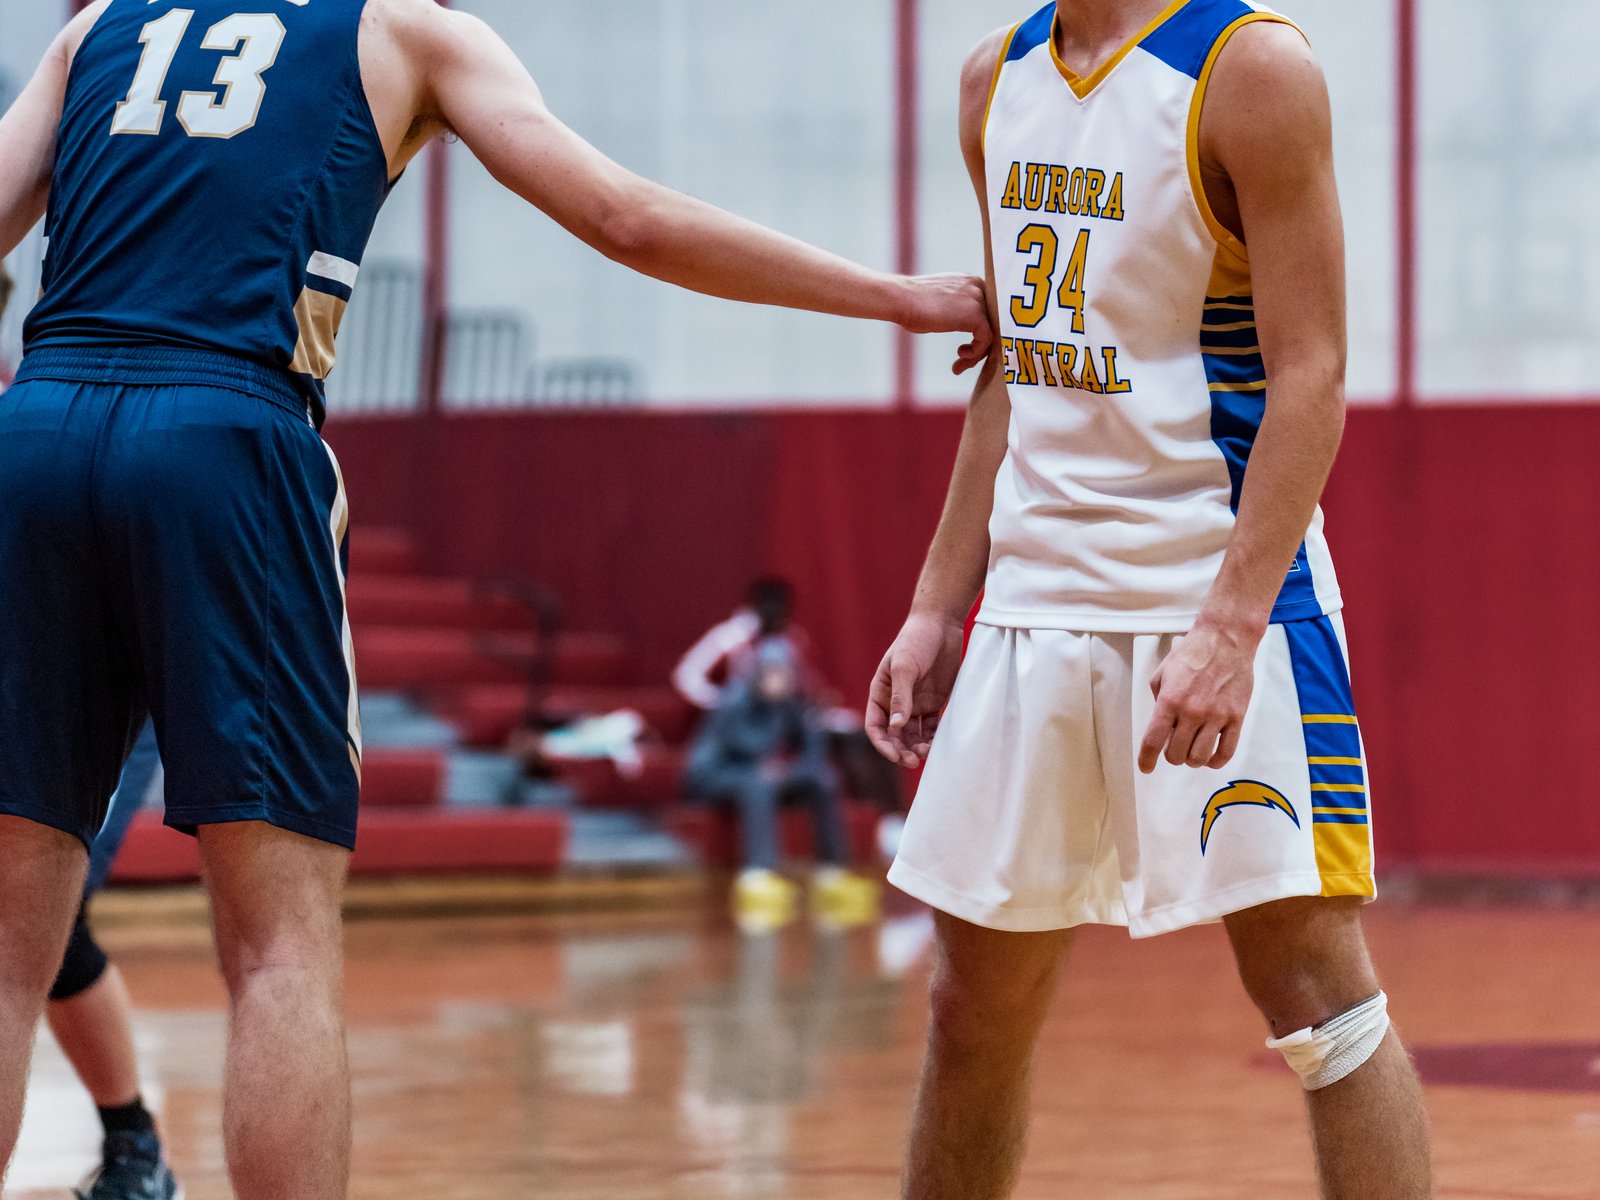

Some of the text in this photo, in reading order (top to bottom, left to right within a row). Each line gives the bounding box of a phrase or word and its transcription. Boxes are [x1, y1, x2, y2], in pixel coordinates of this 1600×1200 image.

[109, 8, 287, 140] 13
[1001, 161, 1124, 221] AURORA
[1010, 223, 1091, 334] 34
[1001, 336, 1132, 394] ENTRAL
